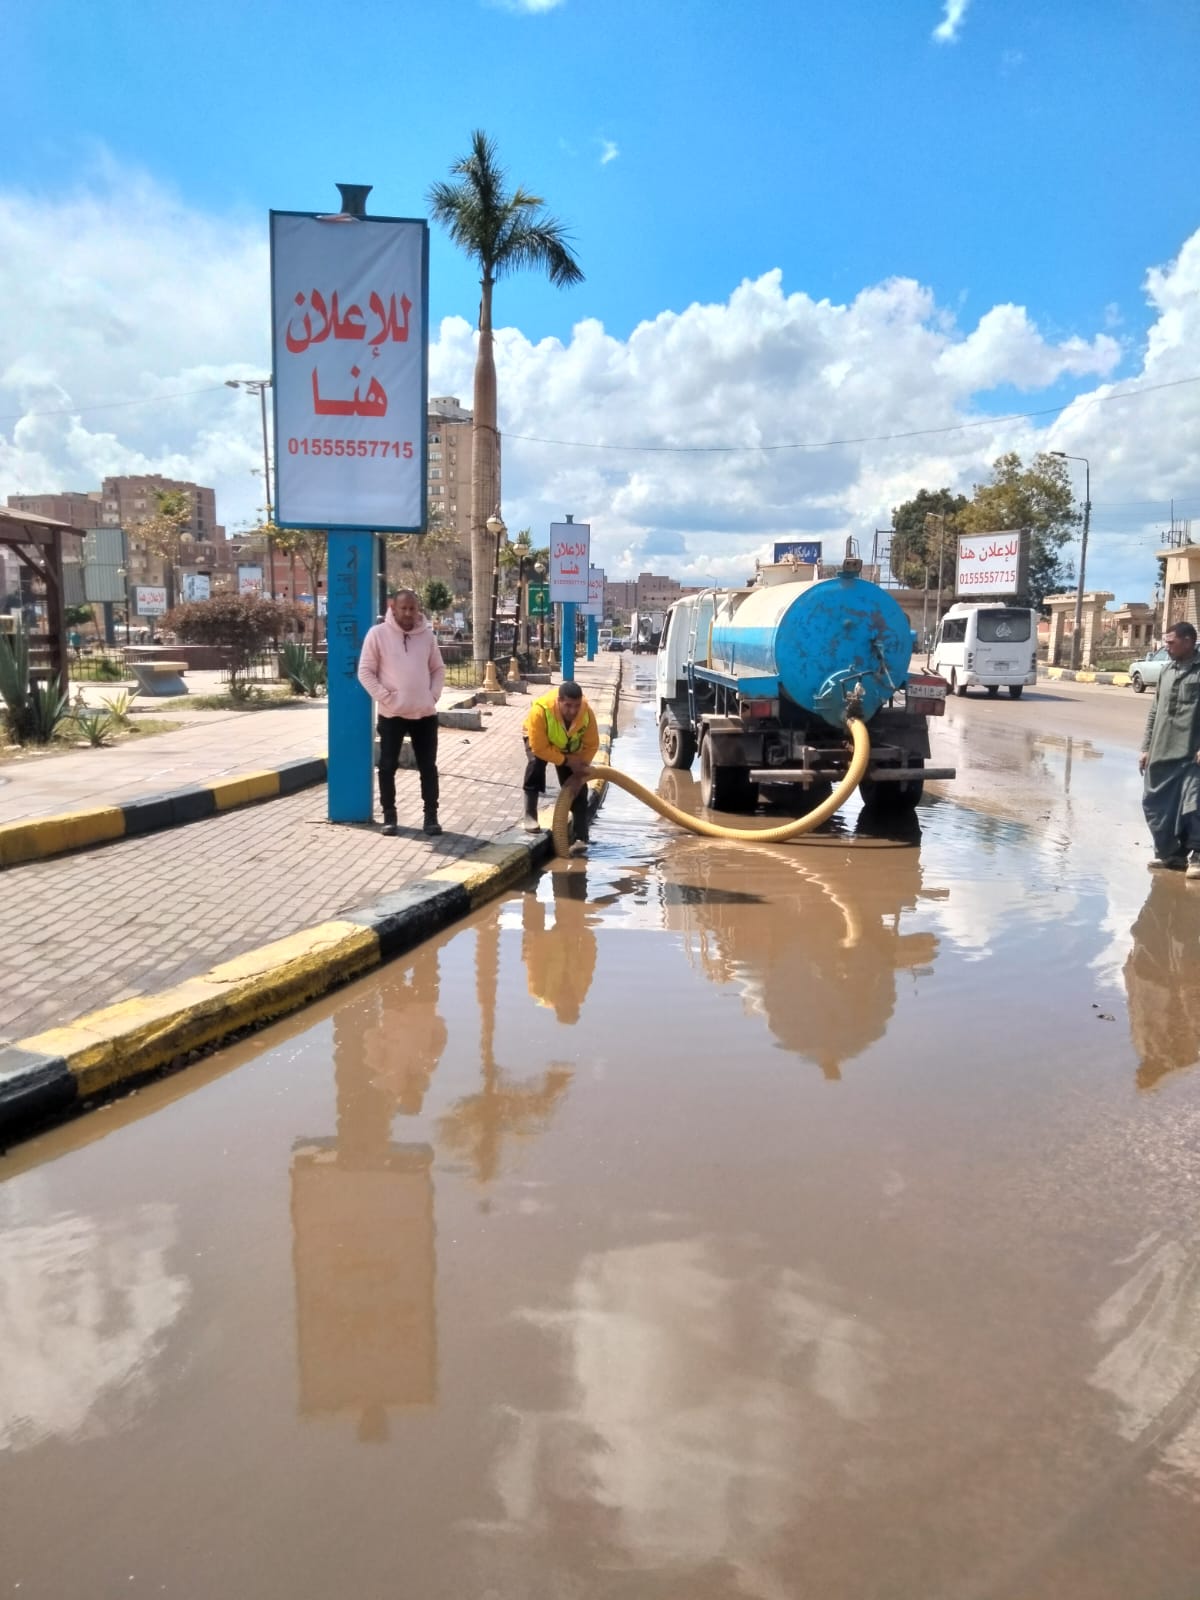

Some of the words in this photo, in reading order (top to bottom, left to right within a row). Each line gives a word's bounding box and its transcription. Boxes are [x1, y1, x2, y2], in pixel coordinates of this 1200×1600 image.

[286, 288, 412, 360] للإعلان
[312, 363, 388, 417] هنا
[288, 438, 413, 459] 01555557715
[960, 545, 975, 560] هنا
[979, 540, 1018, 562] للإعلان
[959, 570, 1016, 585] 01555557715
